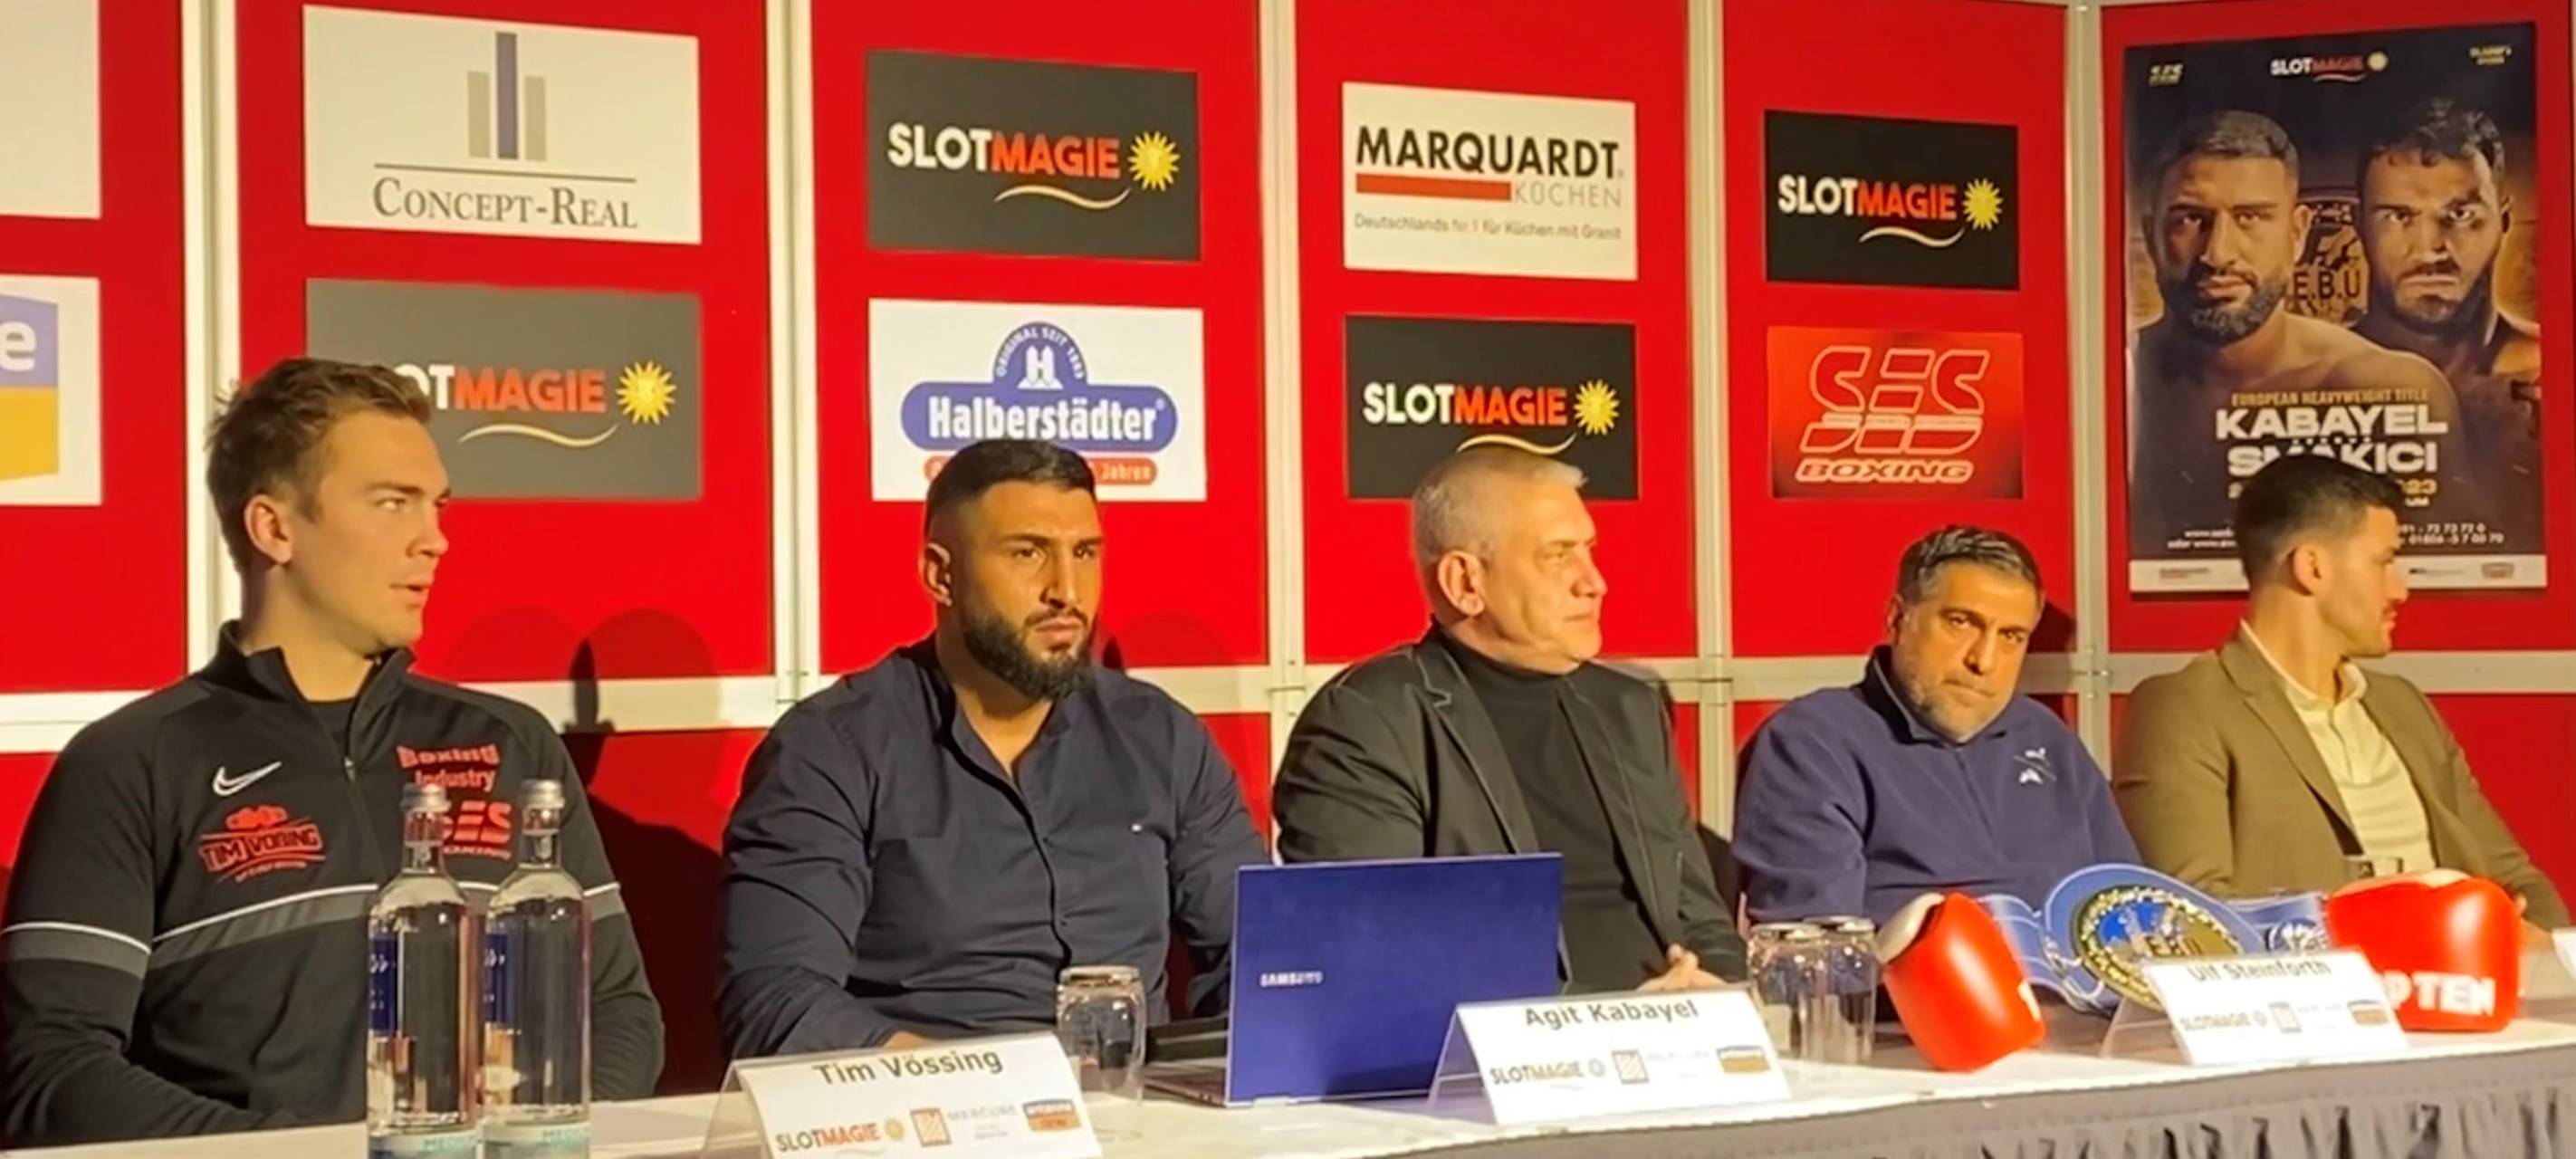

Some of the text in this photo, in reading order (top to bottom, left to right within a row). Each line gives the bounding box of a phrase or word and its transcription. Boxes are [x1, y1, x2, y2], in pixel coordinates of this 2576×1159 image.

[887, 122, 1120, 178] SLOTMAGIE
[1355, 125, 1620, 179] MARQUARDT
[1777, 174, 1957, 220] SLOTMAGIE
[395, 364, 607, 412] TMAGIE
[1363, 381, 1567, 426] SLOTMAGIE
[928, 397, 1156, 440] Halberstädter
[2216, 404, 2449, 440] KABAYEL
[1796, 458, 1974, 484] BOXING
[397, 743, 500, 769] Boxing
[2223, 959, 2333, 980] Steinforth
[1525, 999, 1700, 1030] Agit Kabayel
[815, 1050, 1004, 1085] Tim Vössing
[777, 1122, 881, 1154] SLOTMAGIE
